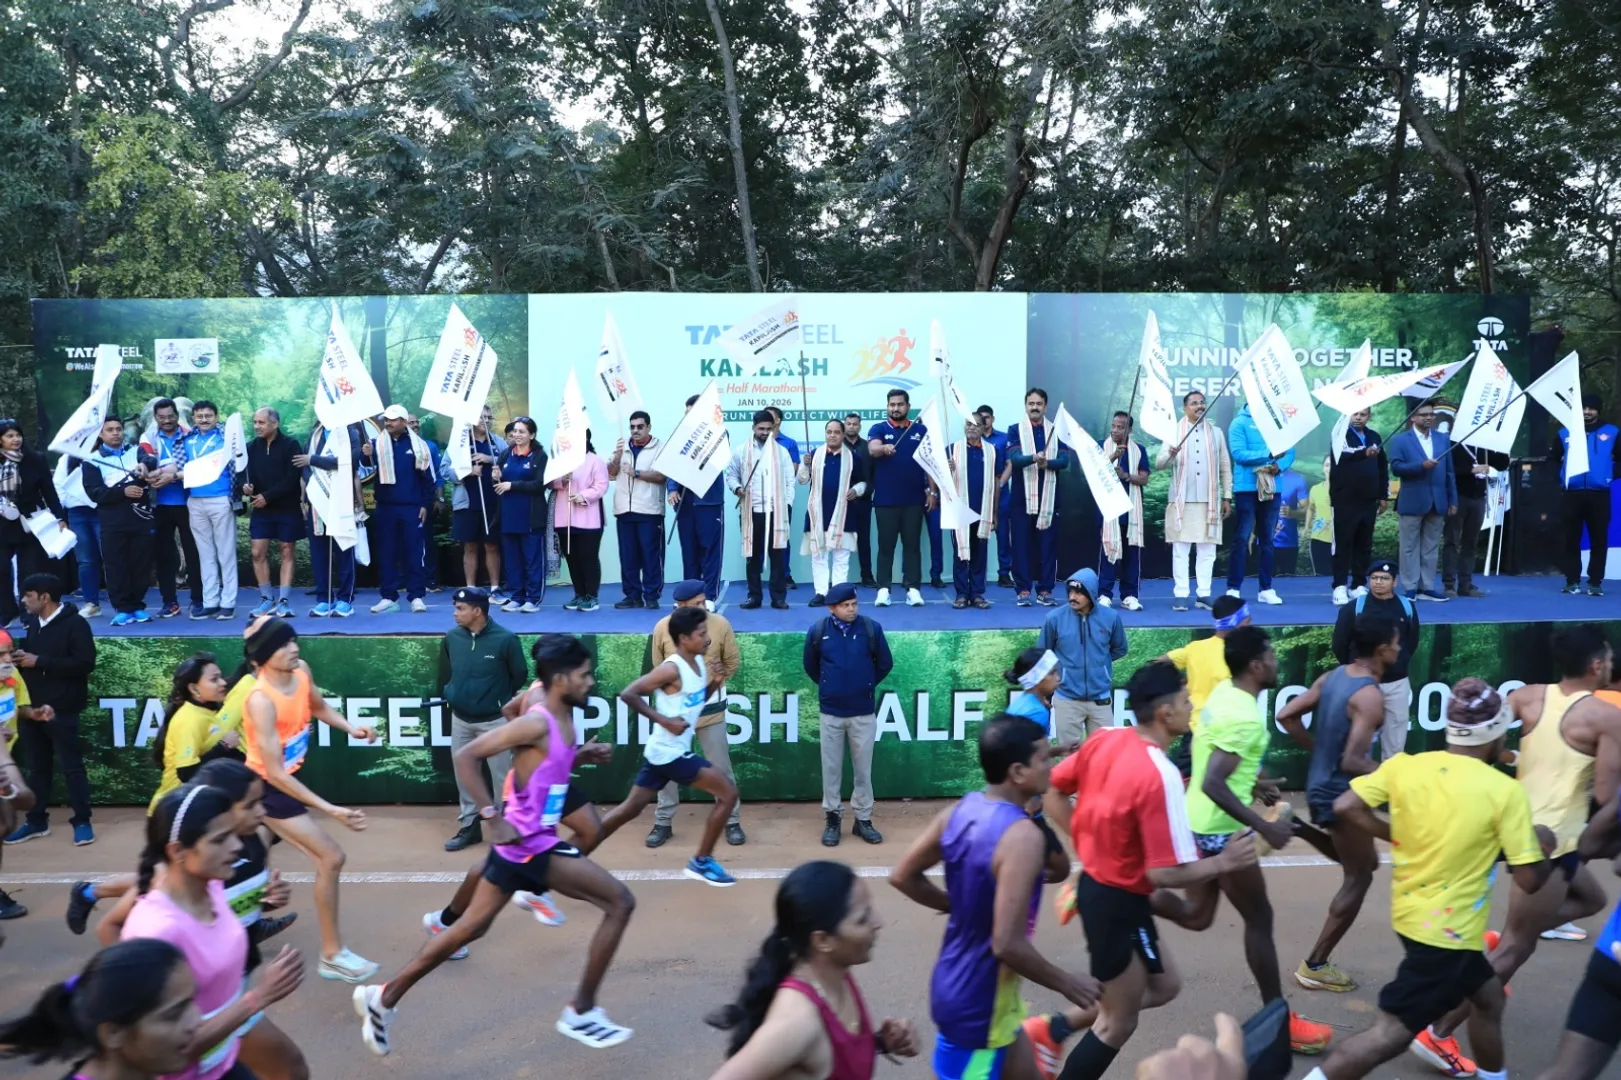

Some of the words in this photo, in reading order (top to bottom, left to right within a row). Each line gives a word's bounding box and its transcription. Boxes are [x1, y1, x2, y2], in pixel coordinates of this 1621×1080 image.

[802, 324, 844, 345] EEL
[1472, 339, 1509, 351] TTA
[440, 370, 454, 394] TATA
[726, 382, 749, 394] Half
[751, 382, 805, 394] Marathon
[737, 399, 754, 407] JAN
[756, 399, 768, 408] 10,
[723, 411, 747, 420] RUN
[1471, 405, 1485, 426] TATA
[679, 439, 695, 456] TATA
[690, 421, 708, 441] STEEL
[99, 698, 166, 747] TA
[315, 698, 452, 747] TEEL
[875, 690, 988, 742] ALF
